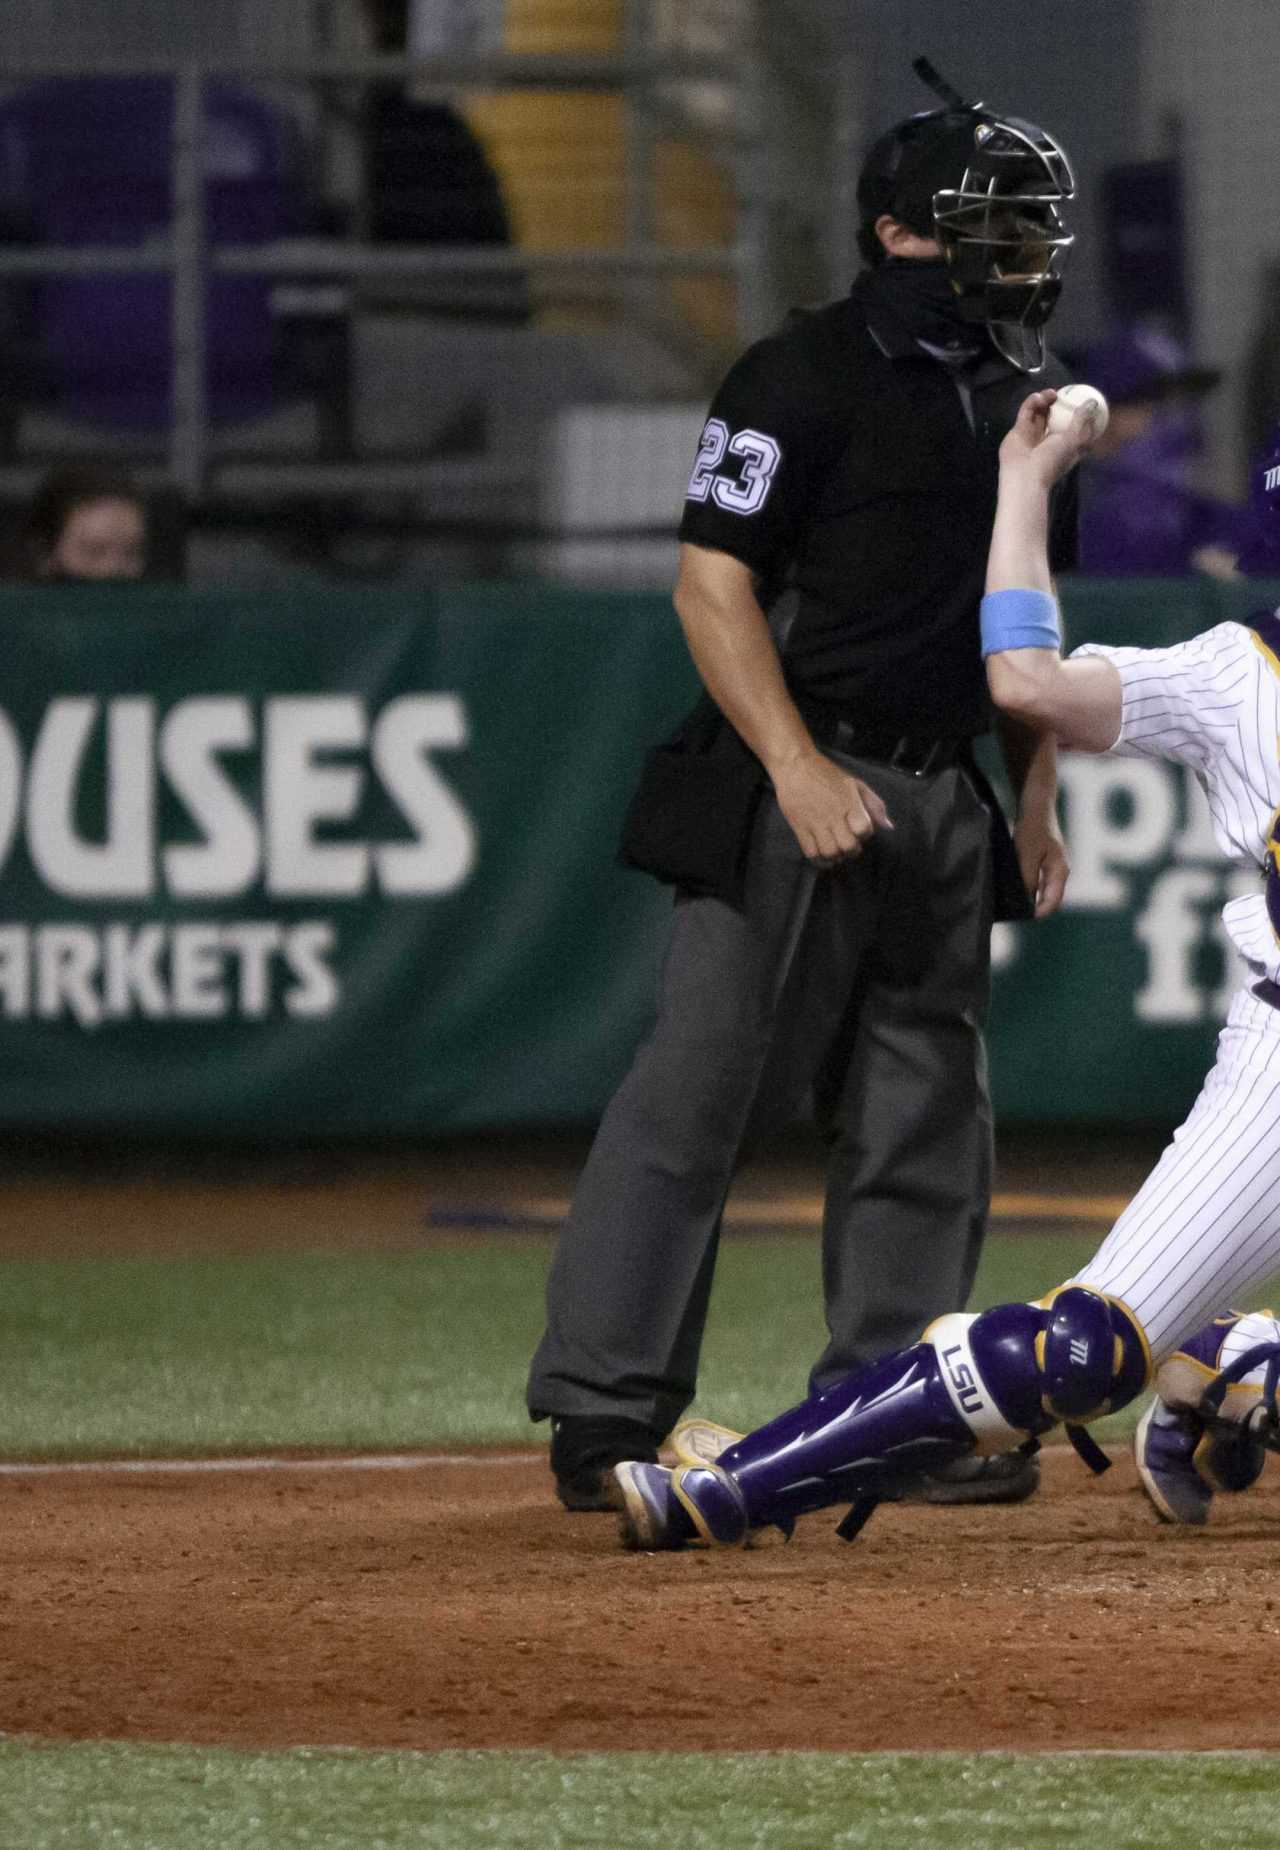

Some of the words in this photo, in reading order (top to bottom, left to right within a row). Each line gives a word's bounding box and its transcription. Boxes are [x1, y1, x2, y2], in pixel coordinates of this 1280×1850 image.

[686, 417, 781, 515] 23
[0, 694, 475, 898] USES
[941, 1344, 983, 1414] LSU
